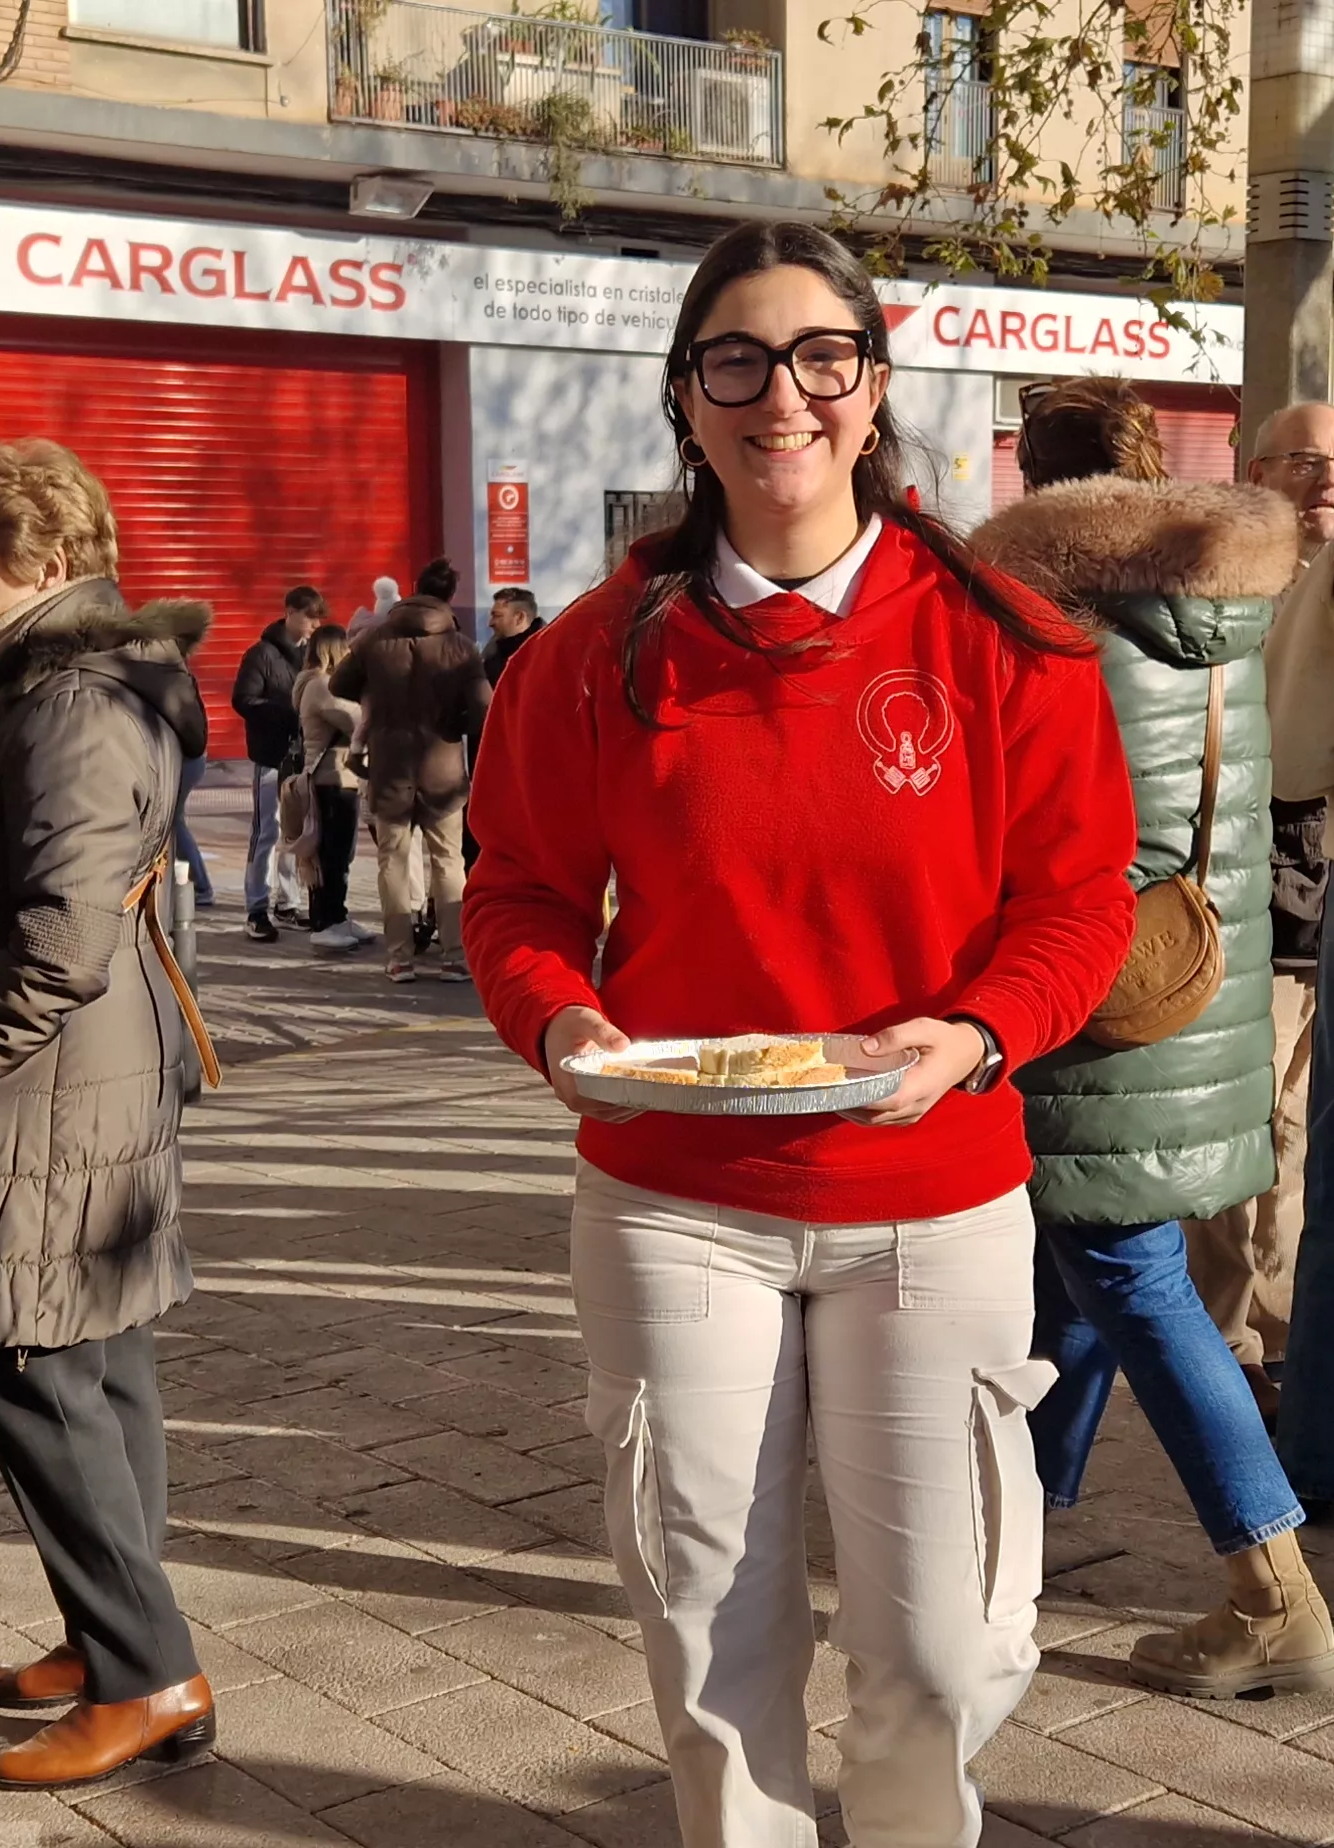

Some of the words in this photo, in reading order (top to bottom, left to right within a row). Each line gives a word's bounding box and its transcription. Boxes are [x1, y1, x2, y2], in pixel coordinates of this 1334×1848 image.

[16, 232, 408, 313] CARGLASS
[473, 273, 489, 291] el
[495, 277, 597, 299] especialista
[603, 285, 623, 300] en
[484, 301, 506, 319] de
[512, 303, 552, 322] todo
[557, 305, 589, 327] tipo
[594, 307, 616, 326] de
[933, 304, 1172, 359] CARGLASS
